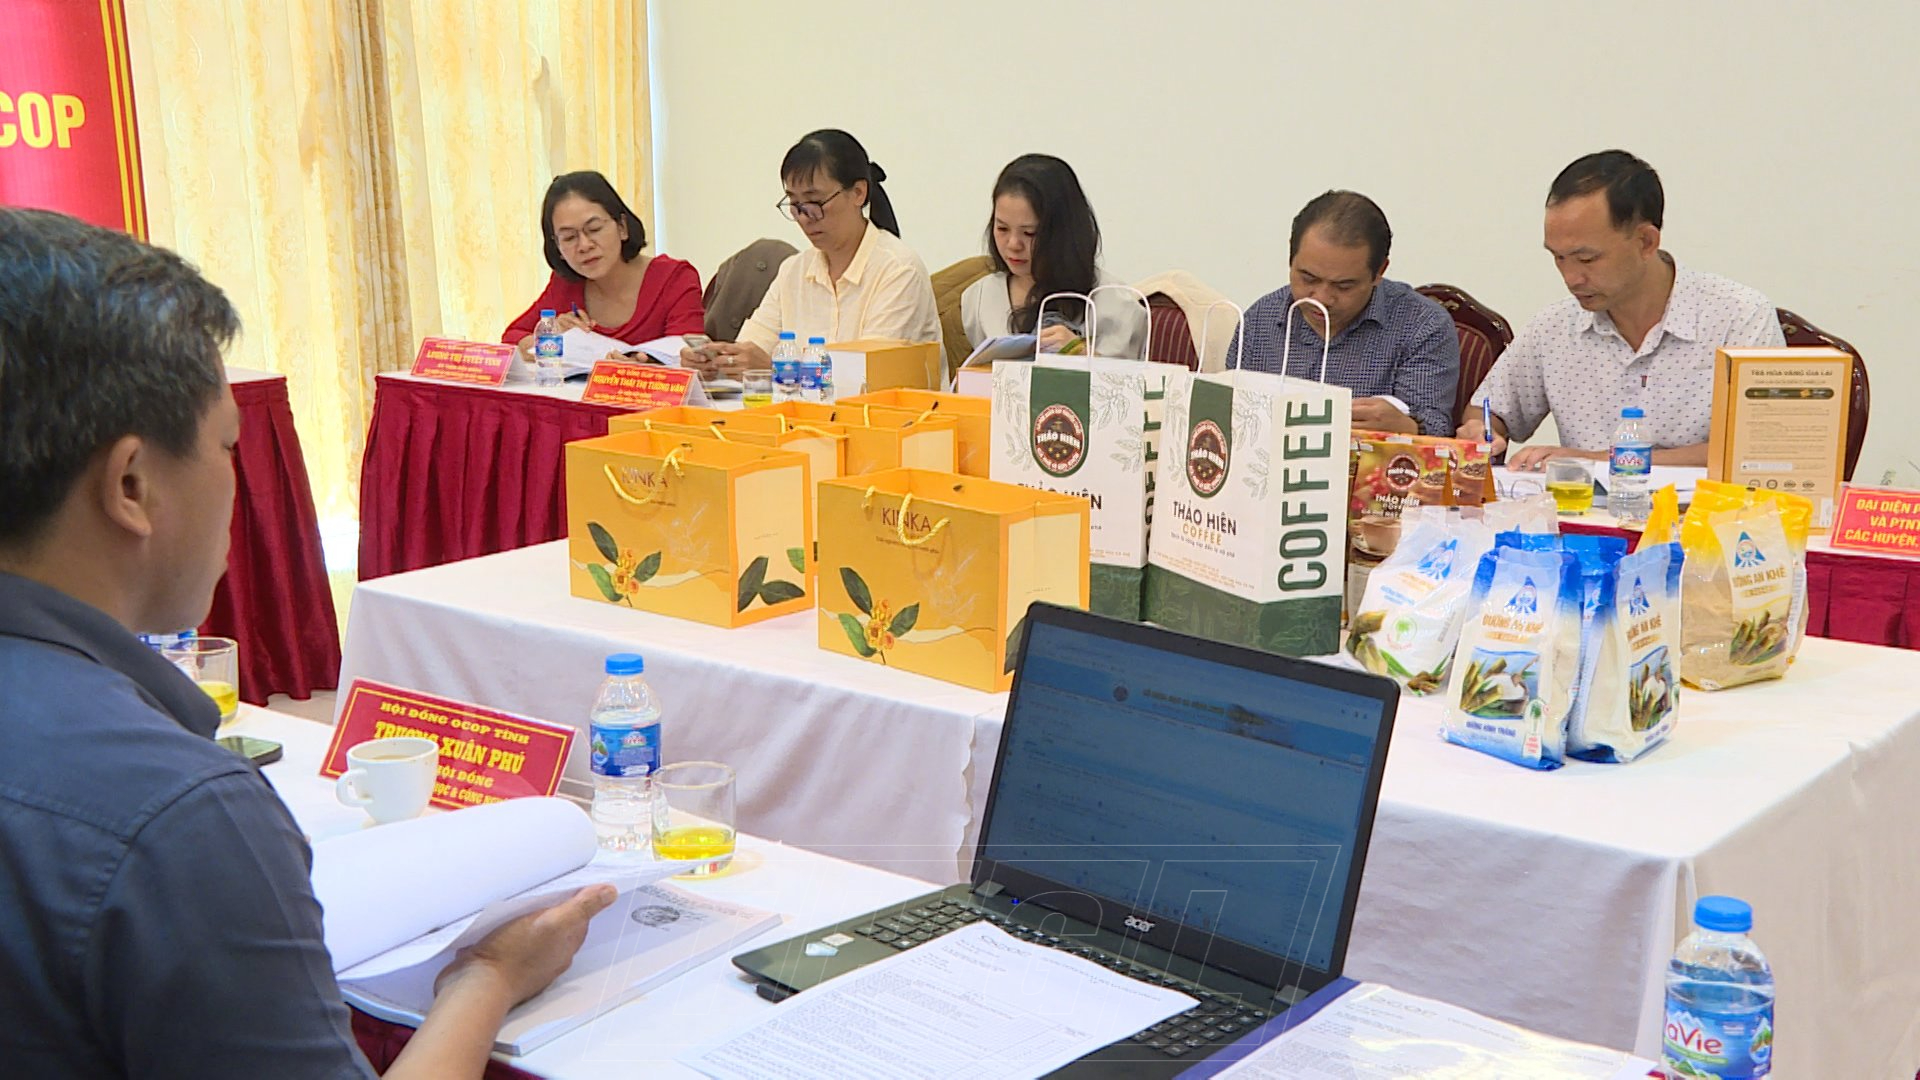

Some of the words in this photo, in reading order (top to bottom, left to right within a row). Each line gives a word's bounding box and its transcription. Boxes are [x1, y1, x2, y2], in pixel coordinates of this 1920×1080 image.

[1278, 399, 1333, 592] COFFEE
[882, 507, 932, 532] KINKA
[1173, 500, 1203, 526] THẢO
[1206, 512, 1237, 536] HIÊN
[1870, 514, 1887, 528] VÀ
[1182, 523, 1222, 546] COFFEE
[1845, 528, 1870, 542] CÁC
[380, 701, 406, 716] HỘI
[451, 718, 491, 735] OCOP
[439, 736, 488, 765] XUÂN
[487, 748, 526, 775] PHÚ
[1124, 915, 1155, 932] acer
[1664, 1017, 1722, 1054] aVie
